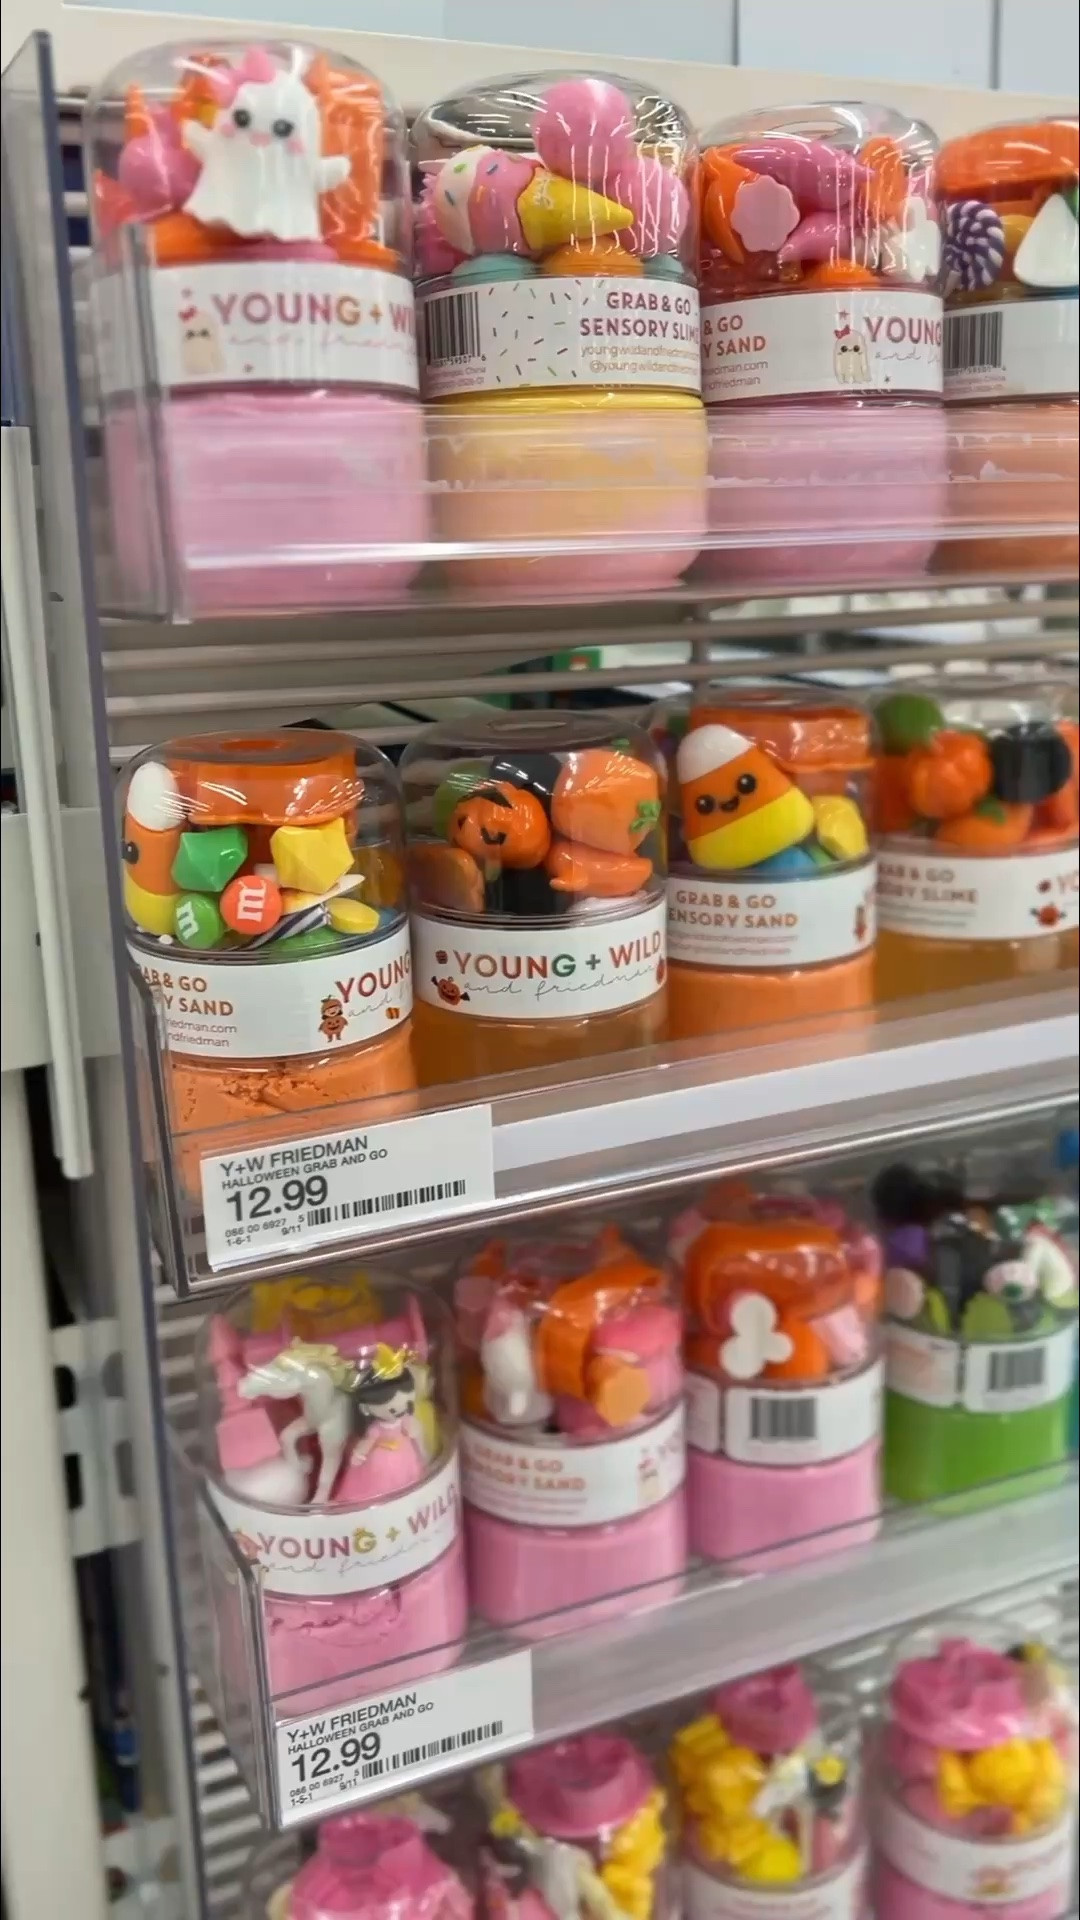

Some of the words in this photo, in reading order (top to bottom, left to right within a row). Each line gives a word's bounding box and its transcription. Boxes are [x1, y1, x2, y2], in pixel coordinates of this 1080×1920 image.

[211, 293, 361, 325] YOUNG
[370, 304, 383, 323] +
[606, 292, 658, 311] GRAB
[661, 296, 671, 312] &
[675, 296, 691, 316] GO
[580, 318, 669, 339] SENSORY
[704, 319, 713, 335] &
[717, 314, 744, 333] GO
[865, 316, 941, 346] YOUNG
[717, 335, 767, 357] SAND
[676, 889, 723, 908] GRAB
[727, 894, 740, 909] &
[747, 894, 776, 909] GO
[744, 912, 799, 929] SAND
[453, 950, 577, 980] YOUNG
[585, 954, 601, 971] +
[608, 930, 661, 969] WILD
[163, 971, 173, 989] &
[178, 975, 207, 993] GO
[335, 951, 411, 1004] YOUNG
[463, 981, 522, 995] and
[179, 997, 233, 1017] SAND
[220, 1155, 265, 1178] Y+W
[270, 1135, 369, 1169] FRIEDMAN
[221, 1165, 300, 1191] HALLOWEEN
[303, 1157, 338, 1174] GRAB
[341, 1151, 367, 1167] AND
[369, 1148, 388, 1161] GO
[226, 1175, 329, 1222] 12.99
[247, 1223, 260, 1233] 00
[298, 1214, 305, 1222] 5
[281, 1224, 302, 1236] 9/11
[256, 1526, 377, 1560] YOUNG
[385, 1527, 400, 1543] +
[287, 1720, 326, 1744] Y+W
[330, 1692, 417, 1731] FRIEDMAN
[287, 1726, 356, 1755] HALLOWEEN
[359, 1715, 390, 1732] GRAB
[392, 1707, 415, 1723] AND
[417, 1701, 434, 1714] GO
[291, 1731, 381, 1782] 12.99
[309, 1782, 320, 1791] 00
[354, 1769, 360, 1777] 5
[339, 1778, 357, 1791] 9/11
